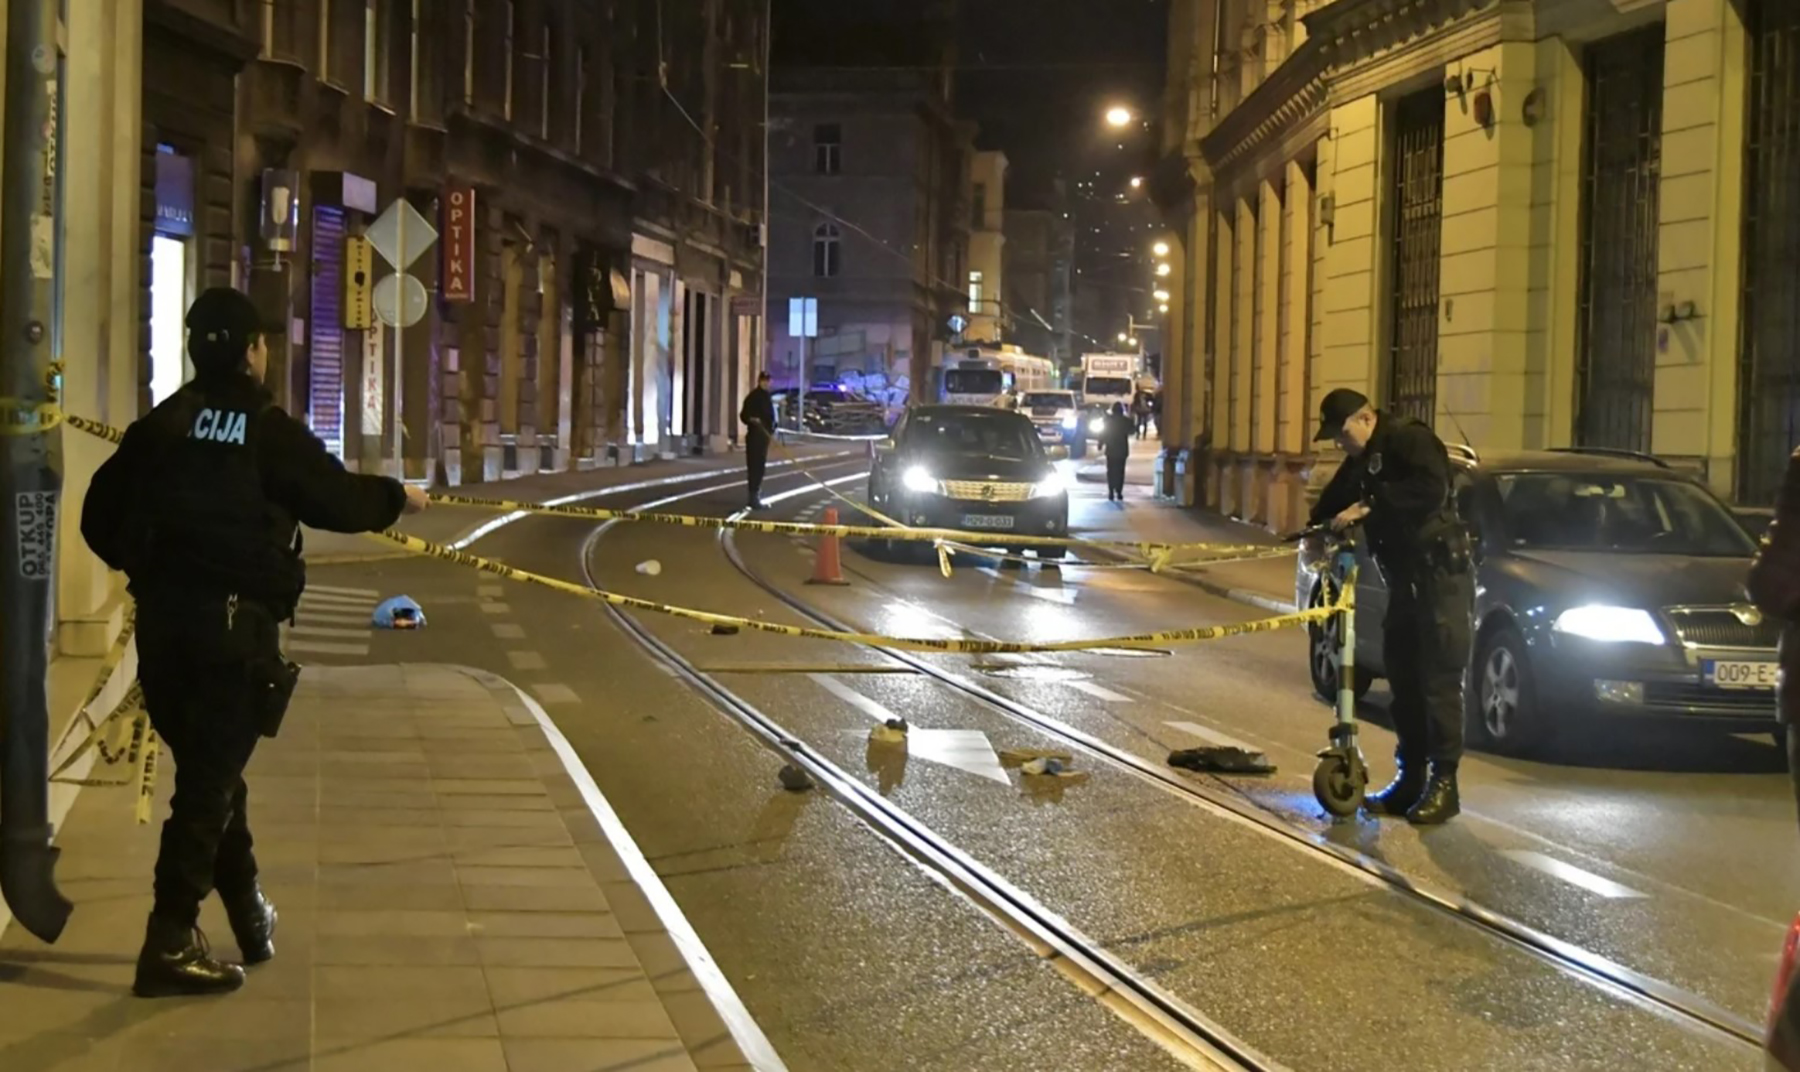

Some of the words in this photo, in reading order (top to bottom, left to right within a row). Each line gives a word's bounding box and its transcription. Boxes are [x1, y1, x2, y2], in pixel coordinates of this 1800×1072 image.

[450, 192, 464, 291] OPTIKA
[187, 408, 247, 445] CIJA
[19, 494, 38, 577] OTKUP
